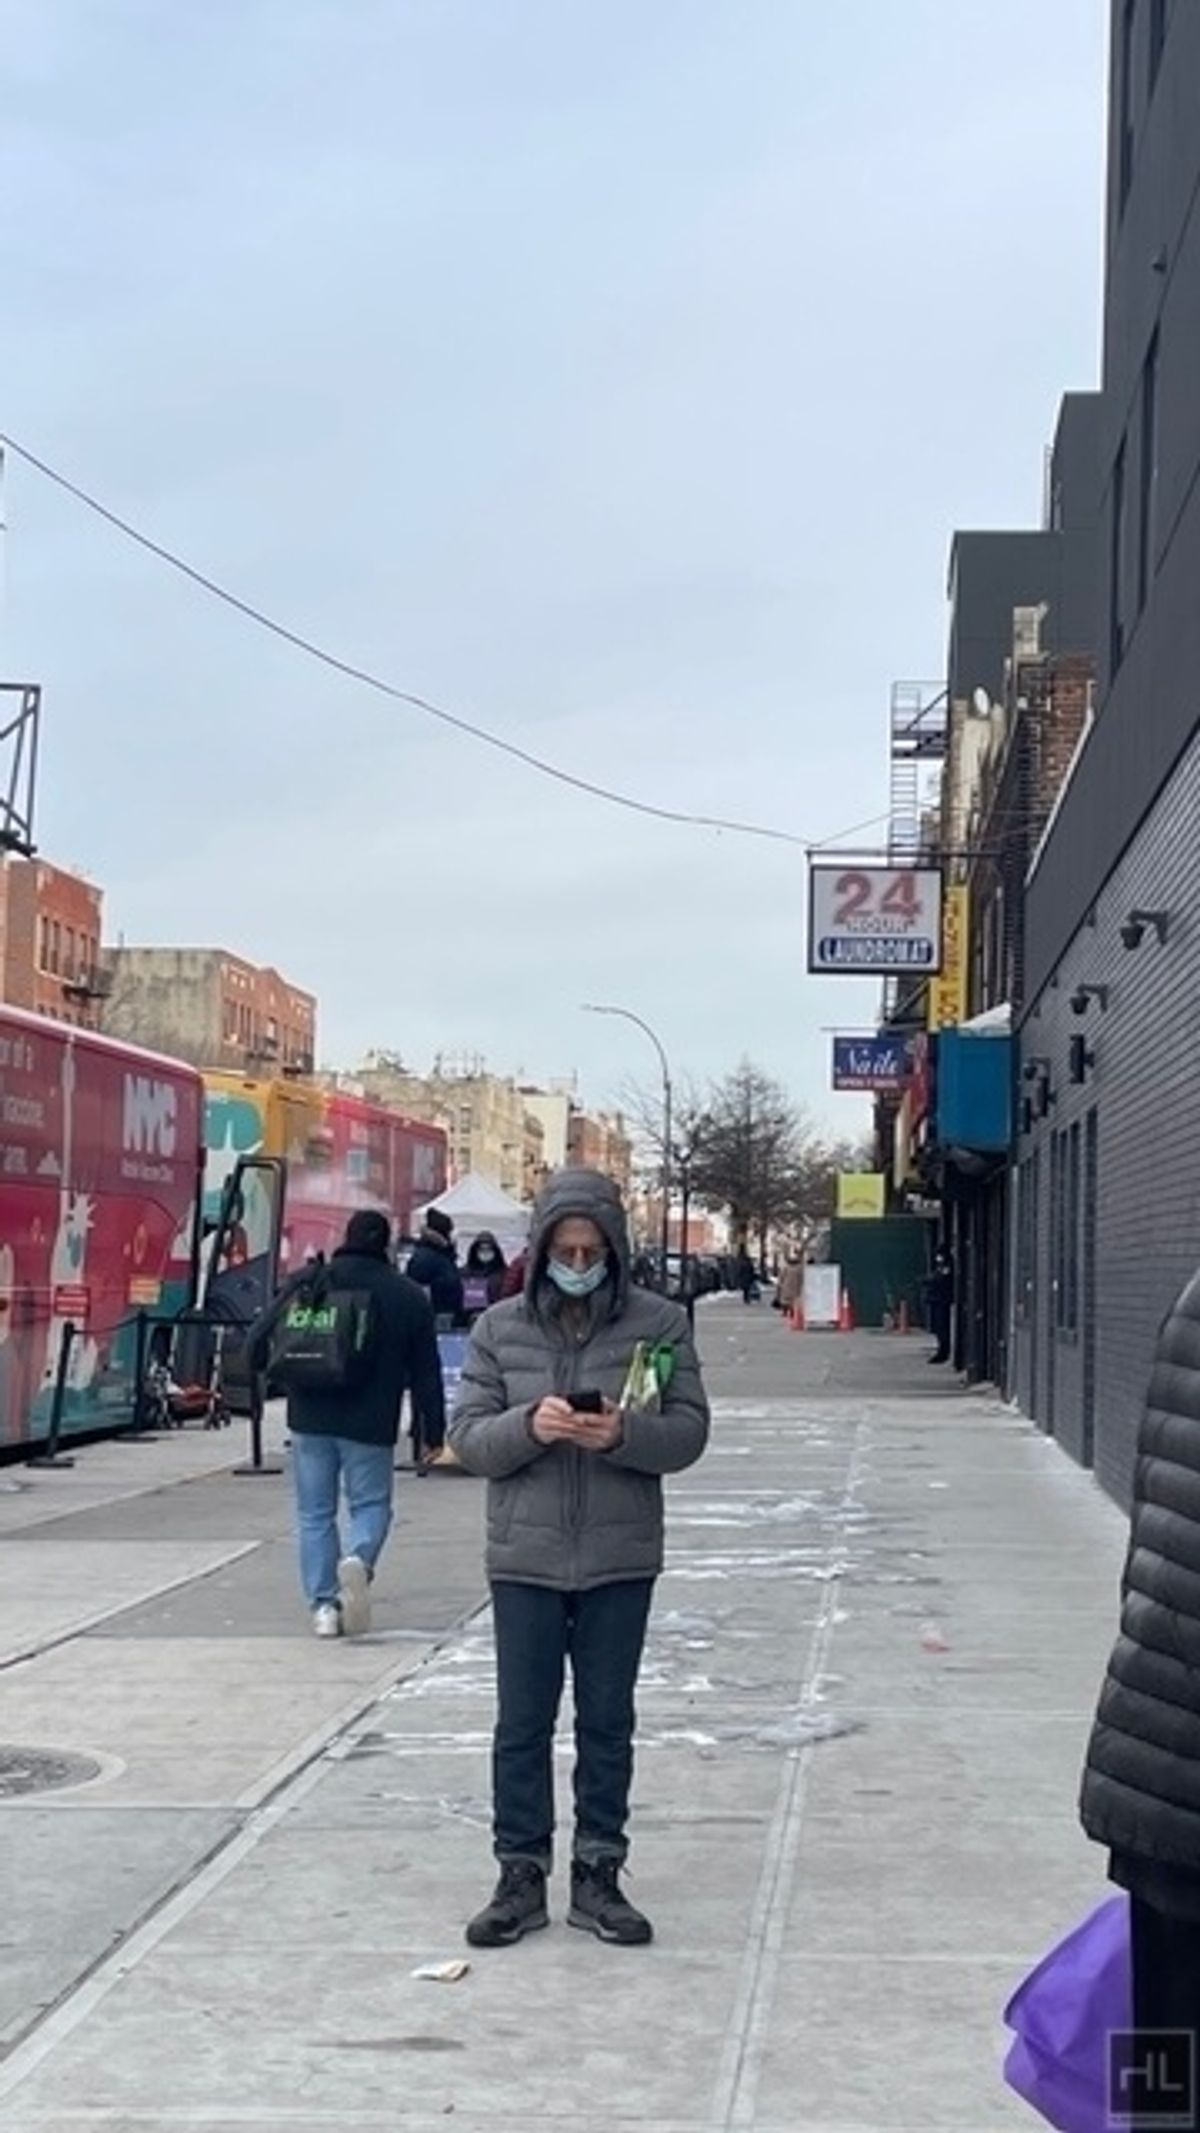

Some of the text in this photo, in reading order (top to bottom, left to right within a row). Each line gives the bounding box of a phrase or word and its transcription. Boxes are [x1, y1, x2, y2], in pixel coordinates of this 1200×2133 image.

[833, 871, 924, 925] 24
[822, 939, 930, 962] LAUNDROMAT
[123, 1073, 178, 1158] NYC
